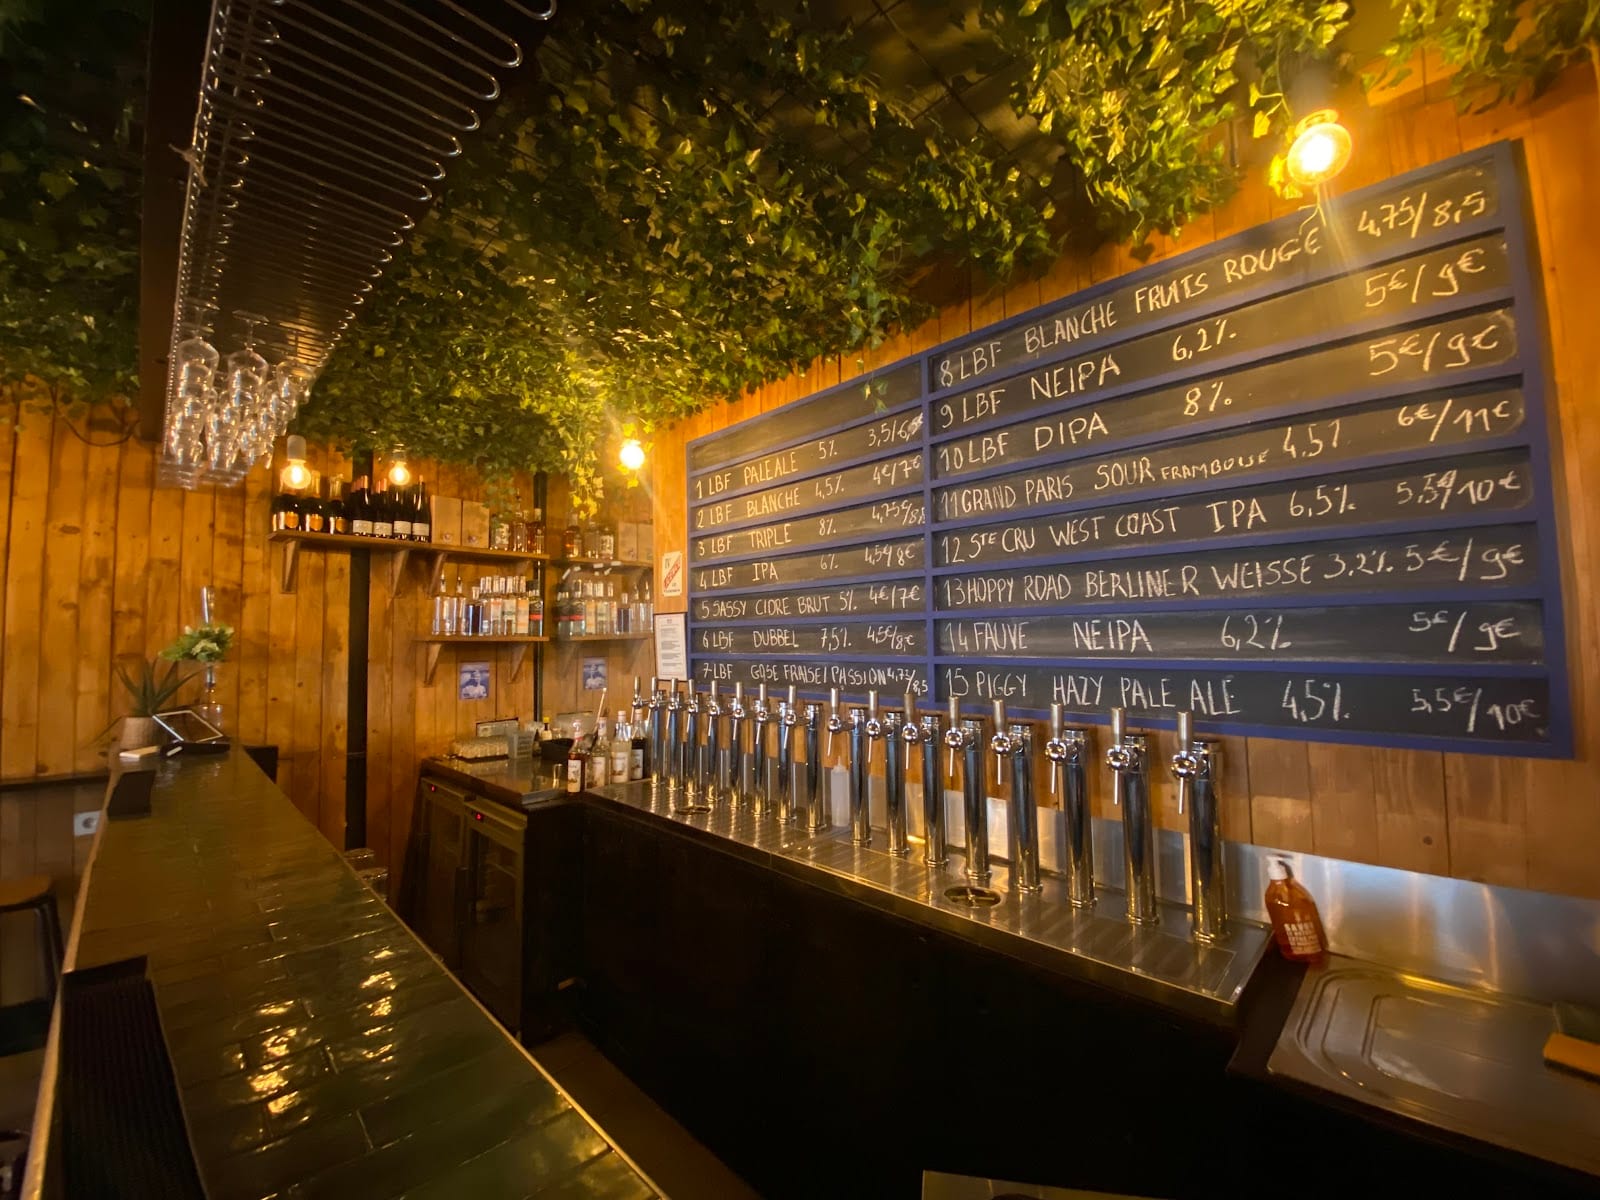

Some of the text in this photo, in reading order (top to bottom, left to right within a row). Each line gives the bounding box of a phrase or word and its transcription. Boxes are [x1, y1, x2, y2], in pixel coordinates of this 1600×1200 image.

[940, 360, 953, 387] 8
[960, 342, 1001, 380] LBF
[1024, 301, 1118, 354] BLANCHE
[1135, 272, 1209, 314] FRUITS
[1223, 227, 1322, 284] ROUGE
[940, 404, 953, 428] 9
[963, 389, 1005, 423] LBF
[1030, 354, 1121, 400] NEIPA
[940, 447, 963, 472] 10
[968, 432, 1008, 464] LBF
[1035, 412, 1109, 451] DIPA
[696, 480, 702, 499] 1
[709, 473, 732, 495] LBF
[941, 490, 958, 518] 11
[961, 485, 1016, 513] GRAND
[1026, 475, 1073, 506] PARIS
[1094, 456, 1156, 491] SOUR
[697, 510, 704, 528] 2
[710, 504, 732, 525] LBF
[747, 487, 800, 517] BLANCHE
[698, 541, 705, 556] 3
[711, 535, 733, 553] LBF
[750, 528, 792, 549] TRIPLE
[941, 536, 965, 564] 12
[1002, 528, 1035, 553] CRU
[1049, 516, 1105, 547] WEST
[1116, 506, 1180, 537] COAST
[1206, 498, 1267, 533] IPA
[699, 572, 707, 590] 4
[712, 566, 733, 587] LBF
[752, 562, 779, 582] IPA
[944, 578, 966, 607] 13
[968, 577, 1014, 604] HOPPY
[1024, 573, 1072, 601] ROAD
[1212, 554, 1315, 591] WEISSE
[701, 601, 710, 619] 5
[712, 599, 747, 618] SASSY
[755, 597, 791, 616] CIDRE
[798, 595, 831, 615] BRUT
[702, 630, 709, 649] 6
[712, 631, 735, 650] LBF
[753, 630, 800, 648] DUBBEL
[945, 621, 968, 653] 14
[973, 621, 1030, 651] FAUVE
[1073, 618, 1152, 653] NEIPA
[703, 662, 712, 678] 7
[713, 664, 733, 680] LBF
[750, 664, 779, 681] GOSE
[945, 668, 969, 697] 15
[976, 670, 1027, 699] PIGGY
[1053, 674, 1103, 706] HAZY
[1120, 676, 1176, 709] PALE
[1191, 678, 1241, 716] ALE
